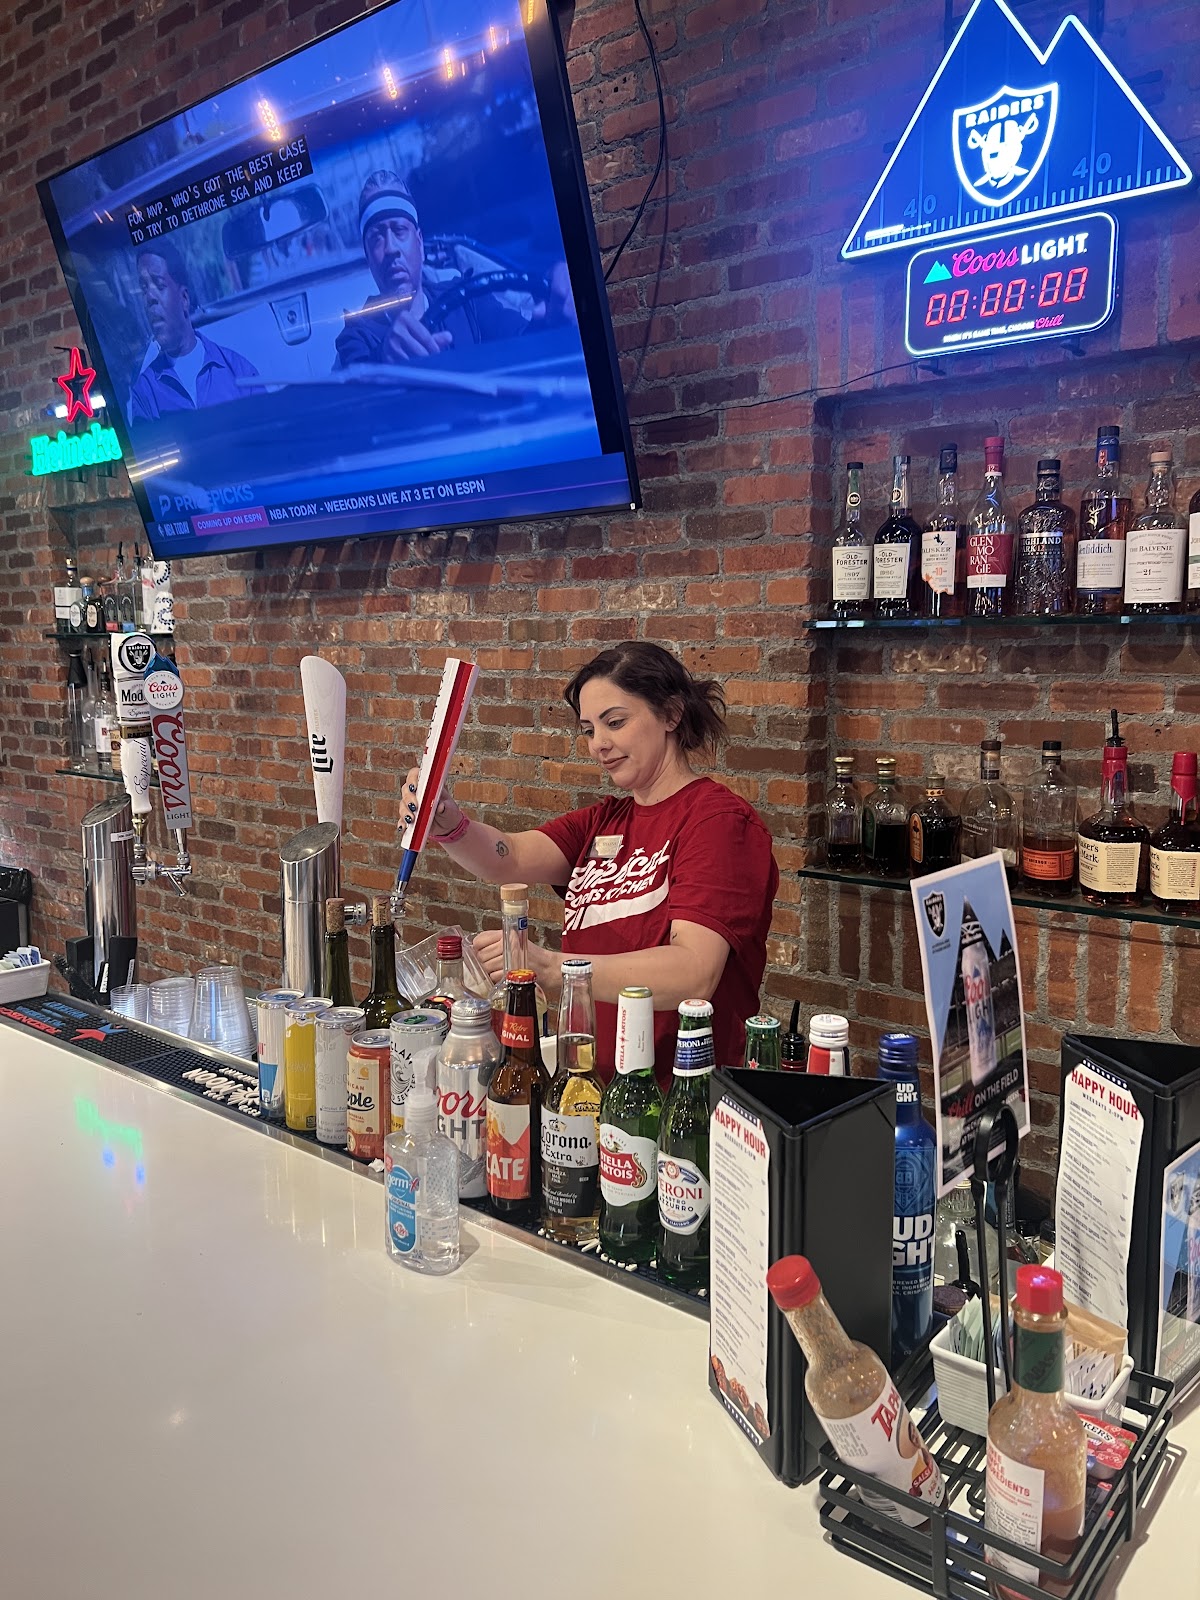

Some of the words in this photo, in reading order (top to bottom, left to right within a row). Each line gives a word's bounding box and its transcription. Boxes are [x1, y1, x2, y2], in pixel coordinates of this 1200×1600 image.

[964, 94, 1045, 129] RAIDERS
[127, 210, 145, 228] FOR
[146, 201, 168, 219] MVP.
[170, 184, 201, 208] WHO'S
[203, 175, 222, 194] GOT
[225, 165, 245, 184] THE
[248, 152, 274, 175] BEST
[278, 138, 306, 162] CASE
[131, 230, 144, 243] TO
[145, 220, 163, 238] TRY
[166, 215, 179, 229] TO
[181, 194, 228, 223] DETHRONE
[230, 184, 251, 204] SGA
[254, 176, 273, 194] AND
[276, 161, 304, 184] KEEP
[951, 246, 1019, 277] Coors
[1021, 233, 1089, 265] LIGHT
[925, 267, 1089, 327] 00:00:00
[1034, 314, 1065, 330] Chill
[30, 422, 123, 476] Heineke
[173, 484, 255, 512] PRIEPICKS
[269, 508, 289, 521] NBA
[289, 503, 318, 518] TODAY
[324, 495, 376, 513] WEEKDAYS
[376, 491, 400, 506] LIVE
[400, 490, 412, 503] AT
[414, 489, 421, 501] 3
[422, 486, 435, 500] ET
[437, 484, 454, 498] ON
[455, 479, 485, 496] ESPN
[164, 523, 176, 537] NBA
[173, 521, 190, 536] TODAY
[197, 517, 223, 530] COMING
[223, 516, 233, 527] UP
[234, 514, 244, 525] ON
[245, 512, 263, 524] ESPN
[970, 536, 994, 547] GLEN
[976, 546, 994, 555] MO
[1023, 537, 1061, 545] IGHLAND
[970, 555, 988, 565] RAN
[976, 564, 991, 574] GIE
[148, 681, 179, 693] Coors
[152, 711, 187, 811] Coors
[312, 733, 334, 774] Lite
[134, 739, 150, 795] Especial
[166, 812, 191, 820] LIGHT
[565, 887, 605, 909] PORTS
[502, 1030, 530, 1042] GINAL
[509, 1022, 528, 1033] Retro
[677, 1039, 700, 1048] PERONI
[896, 1083, 914, 1092] UD
[896, 1091, 918, 1103] GHT
[974, 1089, 987, 1108] ON
[987, 1080, 1000, 1099] THE
[1000, 1068, 1019, 1090] FIELD
[1071, 1068, 1105, 1099] HAPPY
[1109, 1090, 1139, 1120] HOUR
[347, 1092, 374, 1108] ple
[1082, 1092, 1107, 1111] WEEKDAYS
[437, 1115, 486, 1141] GHT
[541, 1122, 592, 1149] Corona
[715, 1107, 741, 1138] HAPPY
[744, 1127, 766, 1158] HOUR
[545, 1145, 572, 1162] Extra
[600, 1151, 632, 1169] STELLA
[486, 1150, 525, 1180] CATE
[600, 1163, 633, 1180] ARTOIS
[893, 1213, 933, 1241] UD
[893, 1238, 935, 1267] GHT
[1082, 1421, 1113, 1442] KER'S
[988, 1464, 1030, 1497] GREDIENTS
